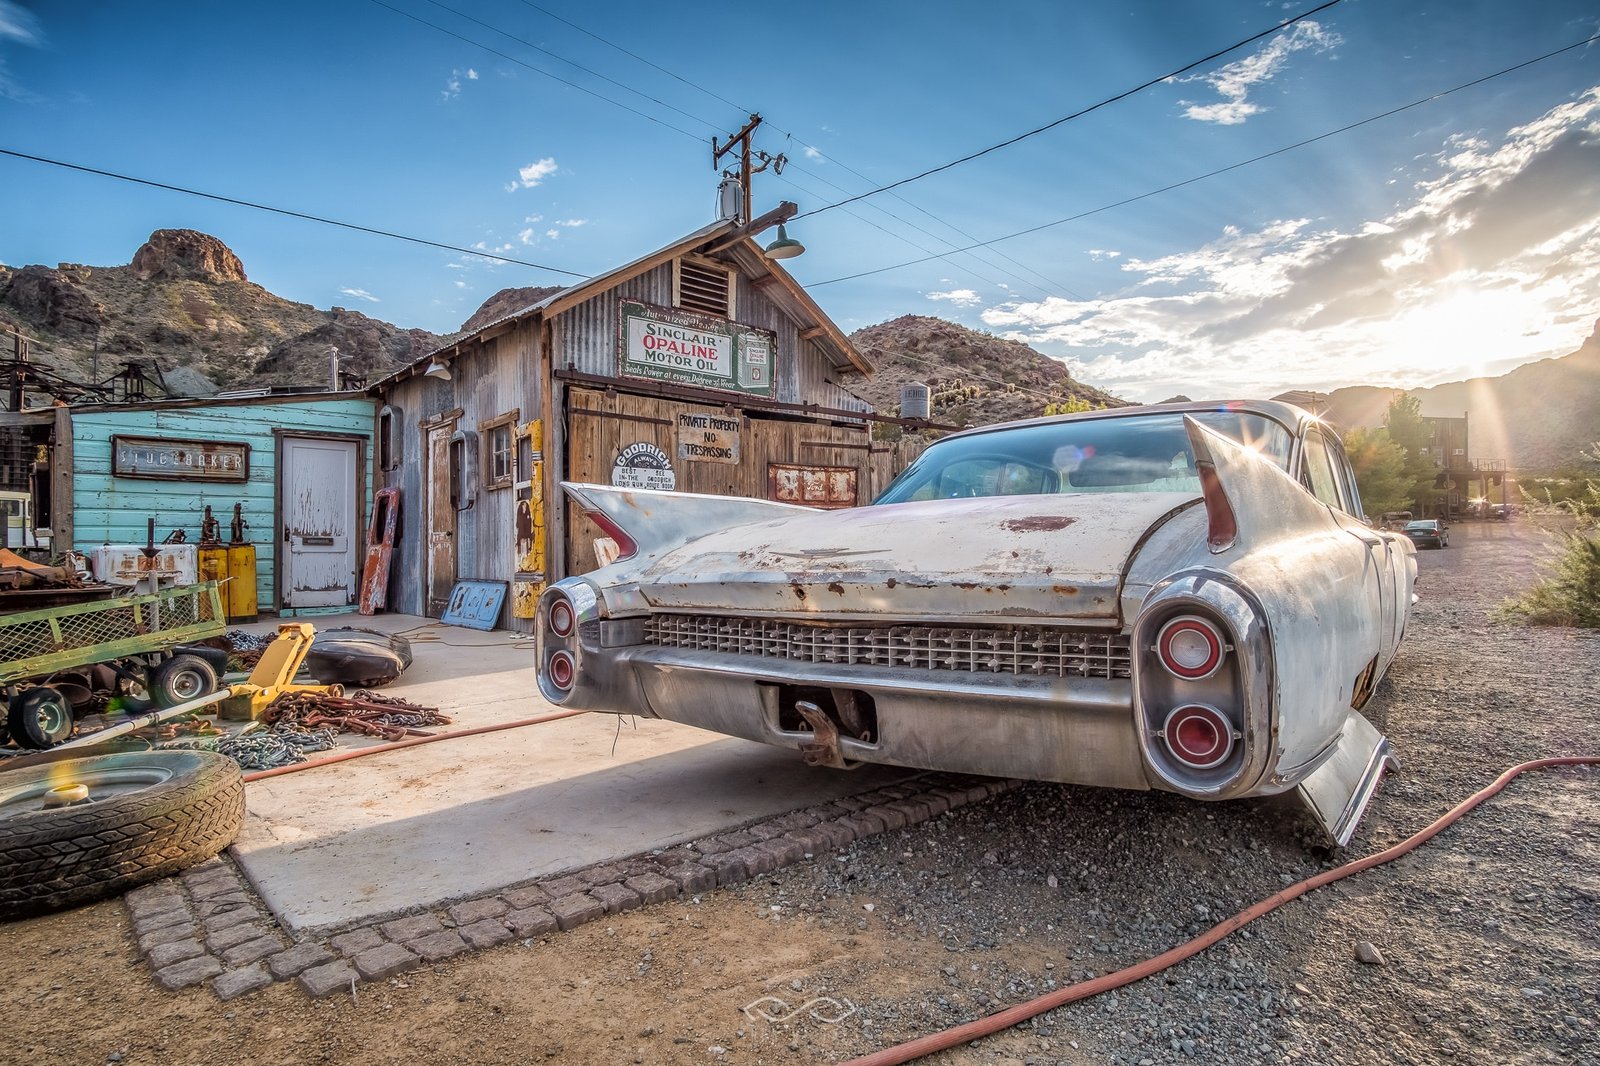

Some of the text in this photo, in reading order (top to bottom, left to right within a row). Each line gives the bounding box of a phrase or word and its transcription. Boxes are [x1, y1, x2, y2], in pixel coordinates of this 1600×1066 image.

[646, 323, 717, 347] SINCLAIR
[643, 335, 719, 360] OPALINE
[644, 349, 717, 371] MOTOR OIL
[624, 363, 642, 375] Seals
[643, 366, 662, 378] Power
[664, 371, 671, 379] at
[673, 372, 691, 382] every
[692, 374, 713, 387] Degree
[720, 378, 735, 389] Wear
[680, 414, 740, 432] PRIVATE PROPERTY
[704, 432, 716, 442] NO
[616, 443, 672, 469] GOODRICH
[634, 456, 658, 466] ALWAYS
[685, 443, 732, 459] TRESPASSING
